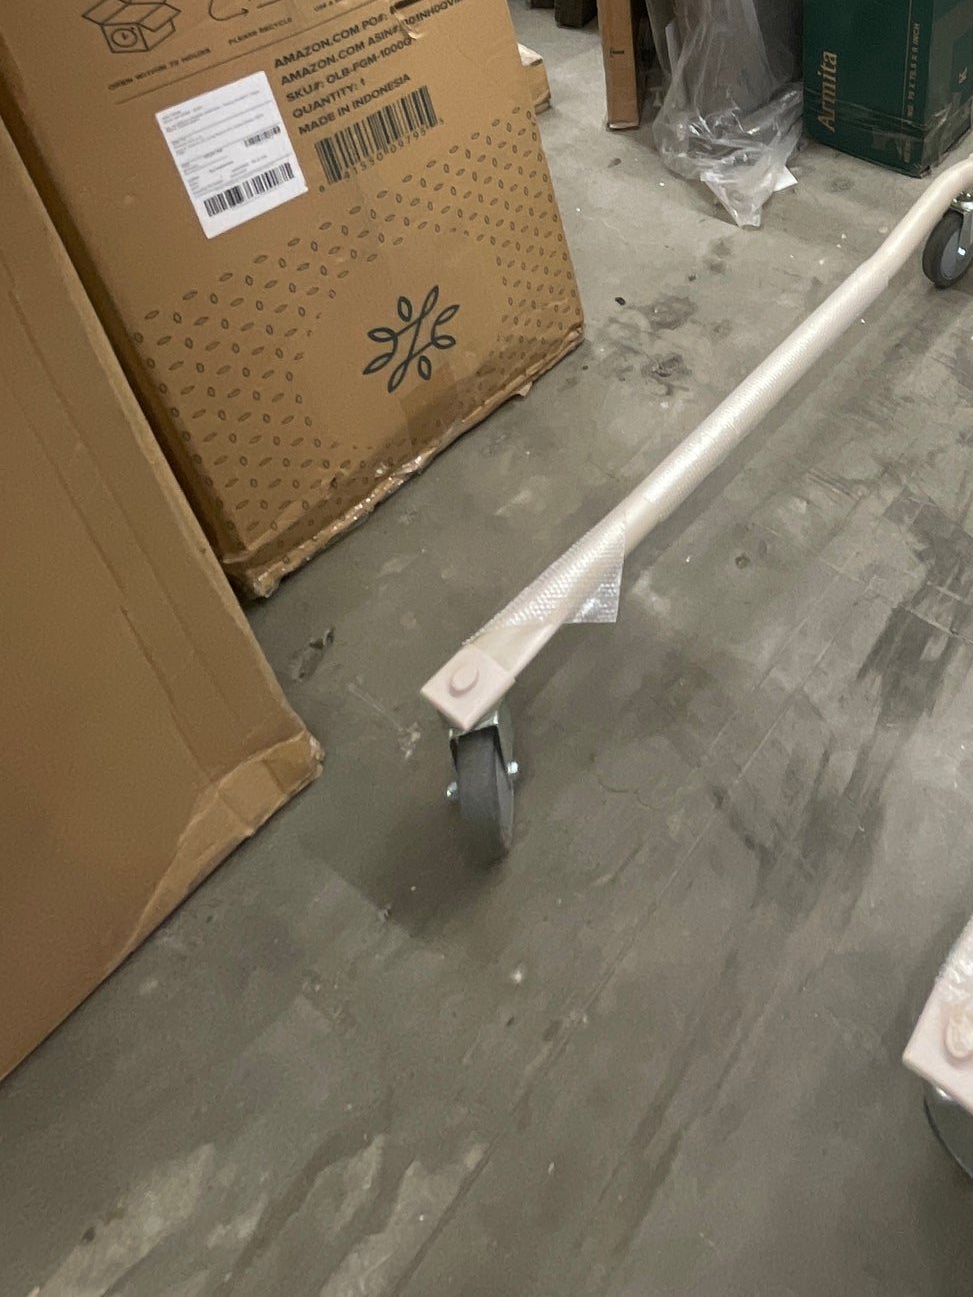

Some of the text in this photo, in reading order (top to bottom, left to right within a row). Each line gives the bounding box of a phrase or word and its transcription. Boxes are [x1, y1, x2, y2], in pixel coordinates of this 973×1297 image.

[274, 25, 361, 69] AMAZON.COM
[281, 41, 366, 87] AMAZON.COM
[286, 81, 325, 103] SKU#:
[291, 83, 359, 120] QUANTITY:
[297, 73, 411, 135] MADE IN INDONESIA
